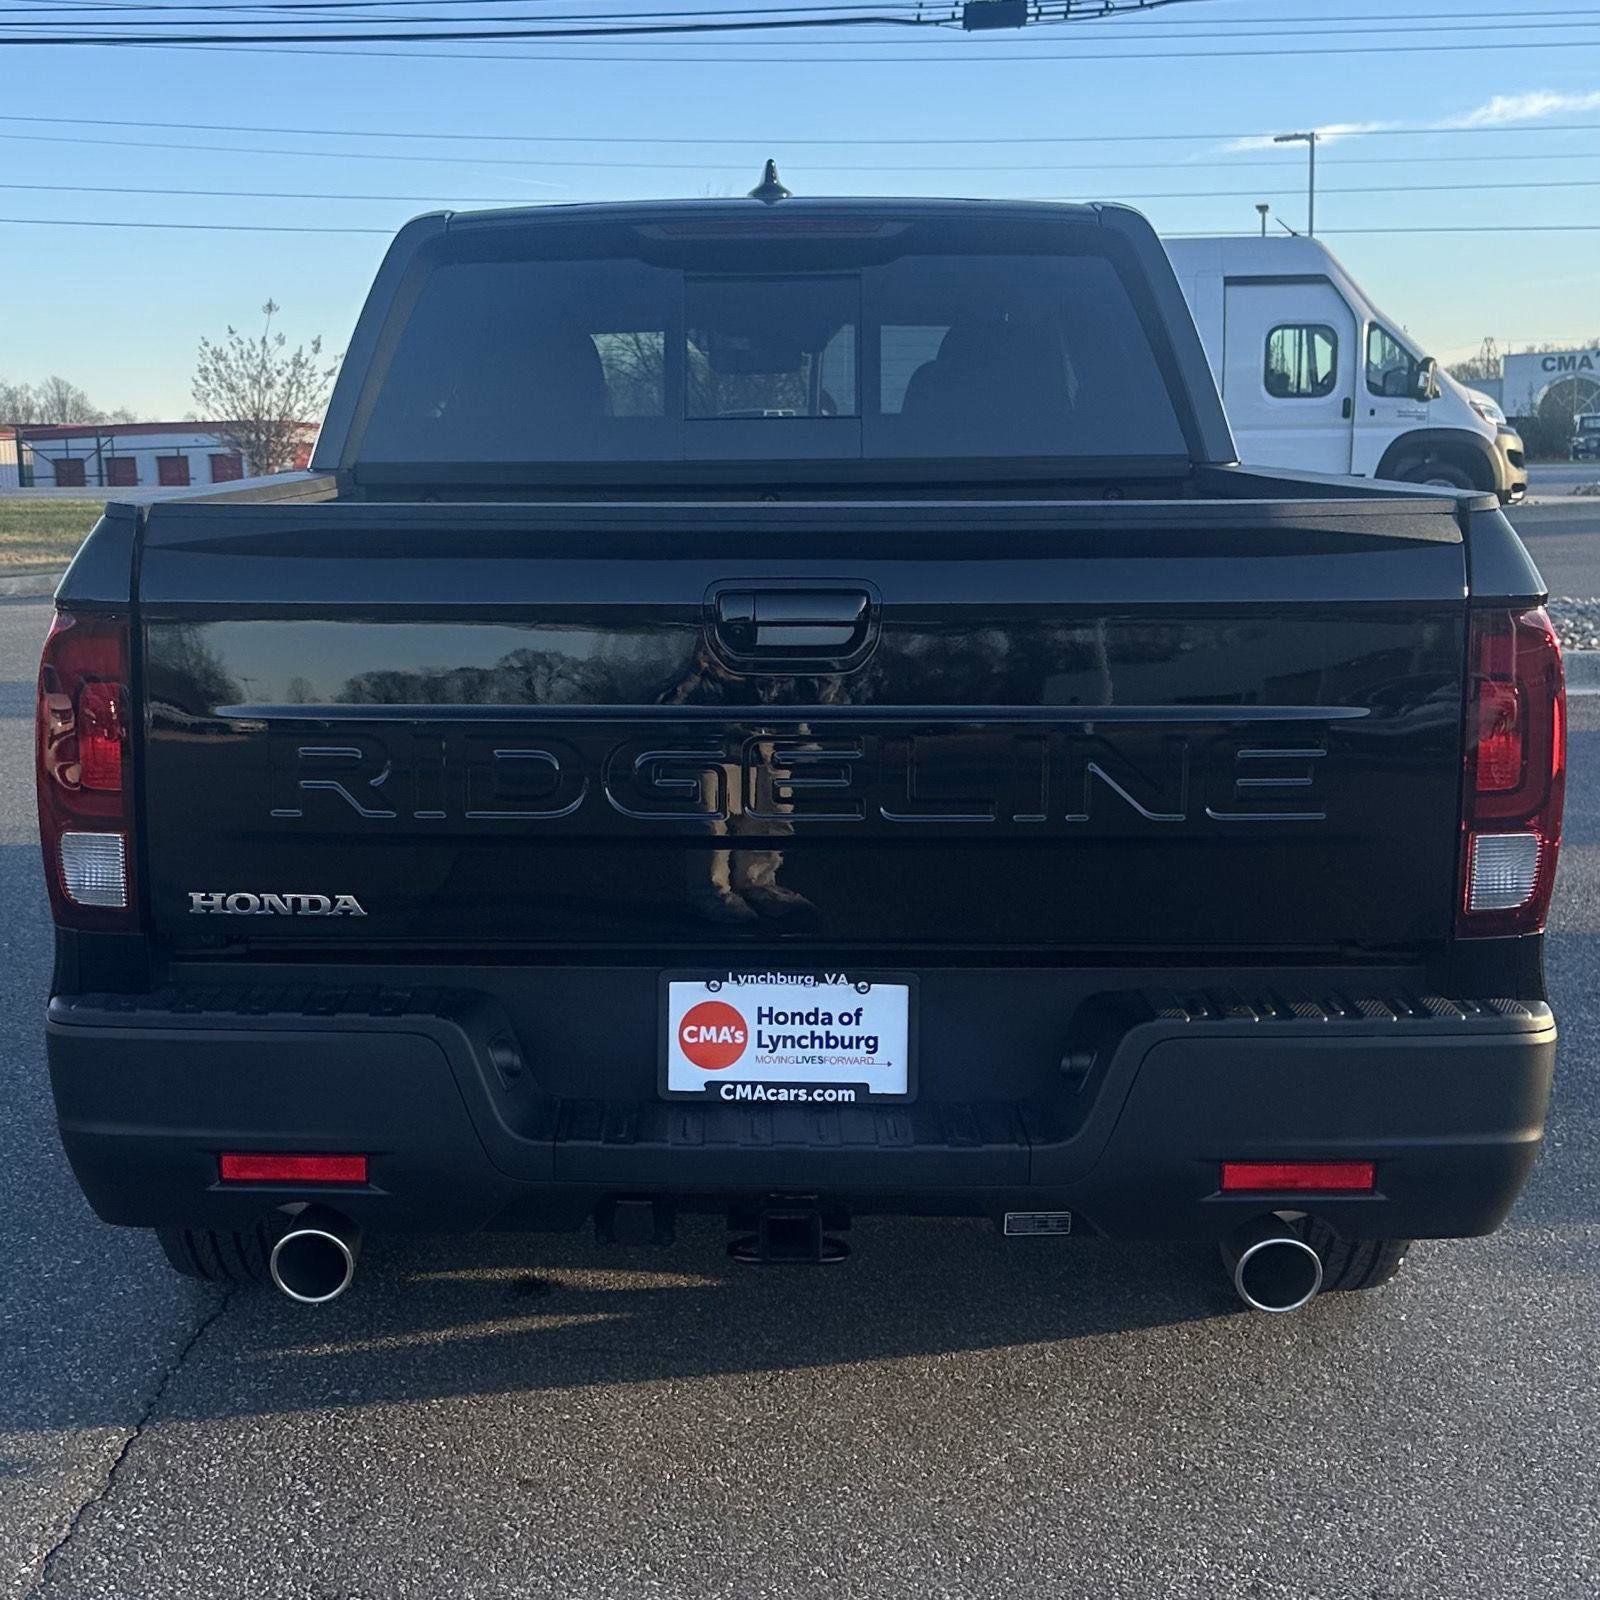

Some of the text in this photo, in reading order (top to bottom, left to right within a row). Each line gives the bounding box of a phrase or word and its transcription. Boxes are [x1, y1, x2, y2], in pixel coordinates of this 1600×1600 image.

[270, 733, 1328, 821] RIDGELINE
[188, 892, 368, 916] HONDA
[728, 972, 849, 987] Lynchburg, VA
[756, 1006, 863, 1026] Honda of
[682, 1025, 745, 1044] CMA's
[756, 1030, 879, 1054] Lynchburg
[719, 1083, 856, 1102] CMAcars.com
